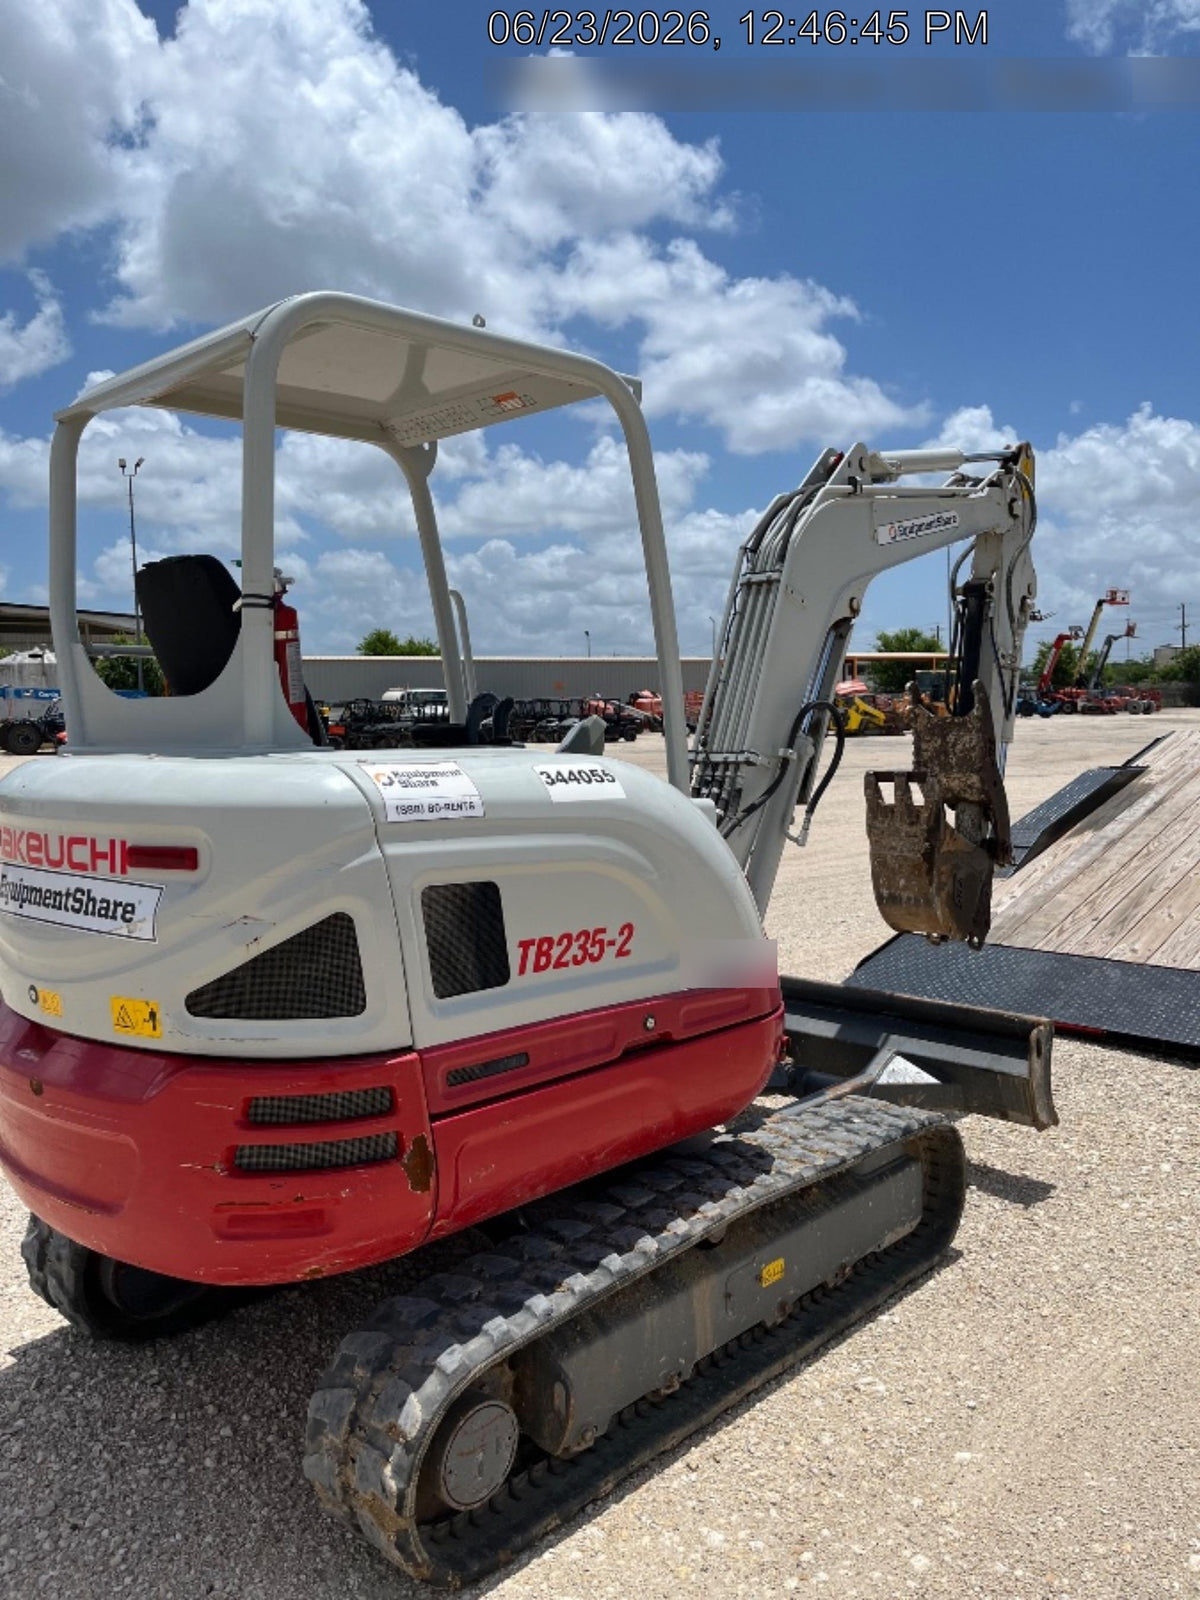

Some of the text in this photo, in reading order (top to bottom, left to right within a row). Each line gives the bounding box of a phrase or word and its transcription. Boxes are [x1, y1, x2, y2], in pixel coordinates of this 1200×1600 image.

[539, 769, 616, 786] 344055
[1, 873, 136, 923] EquipmentShare
[517, 922, 634, 977] TB235-2
